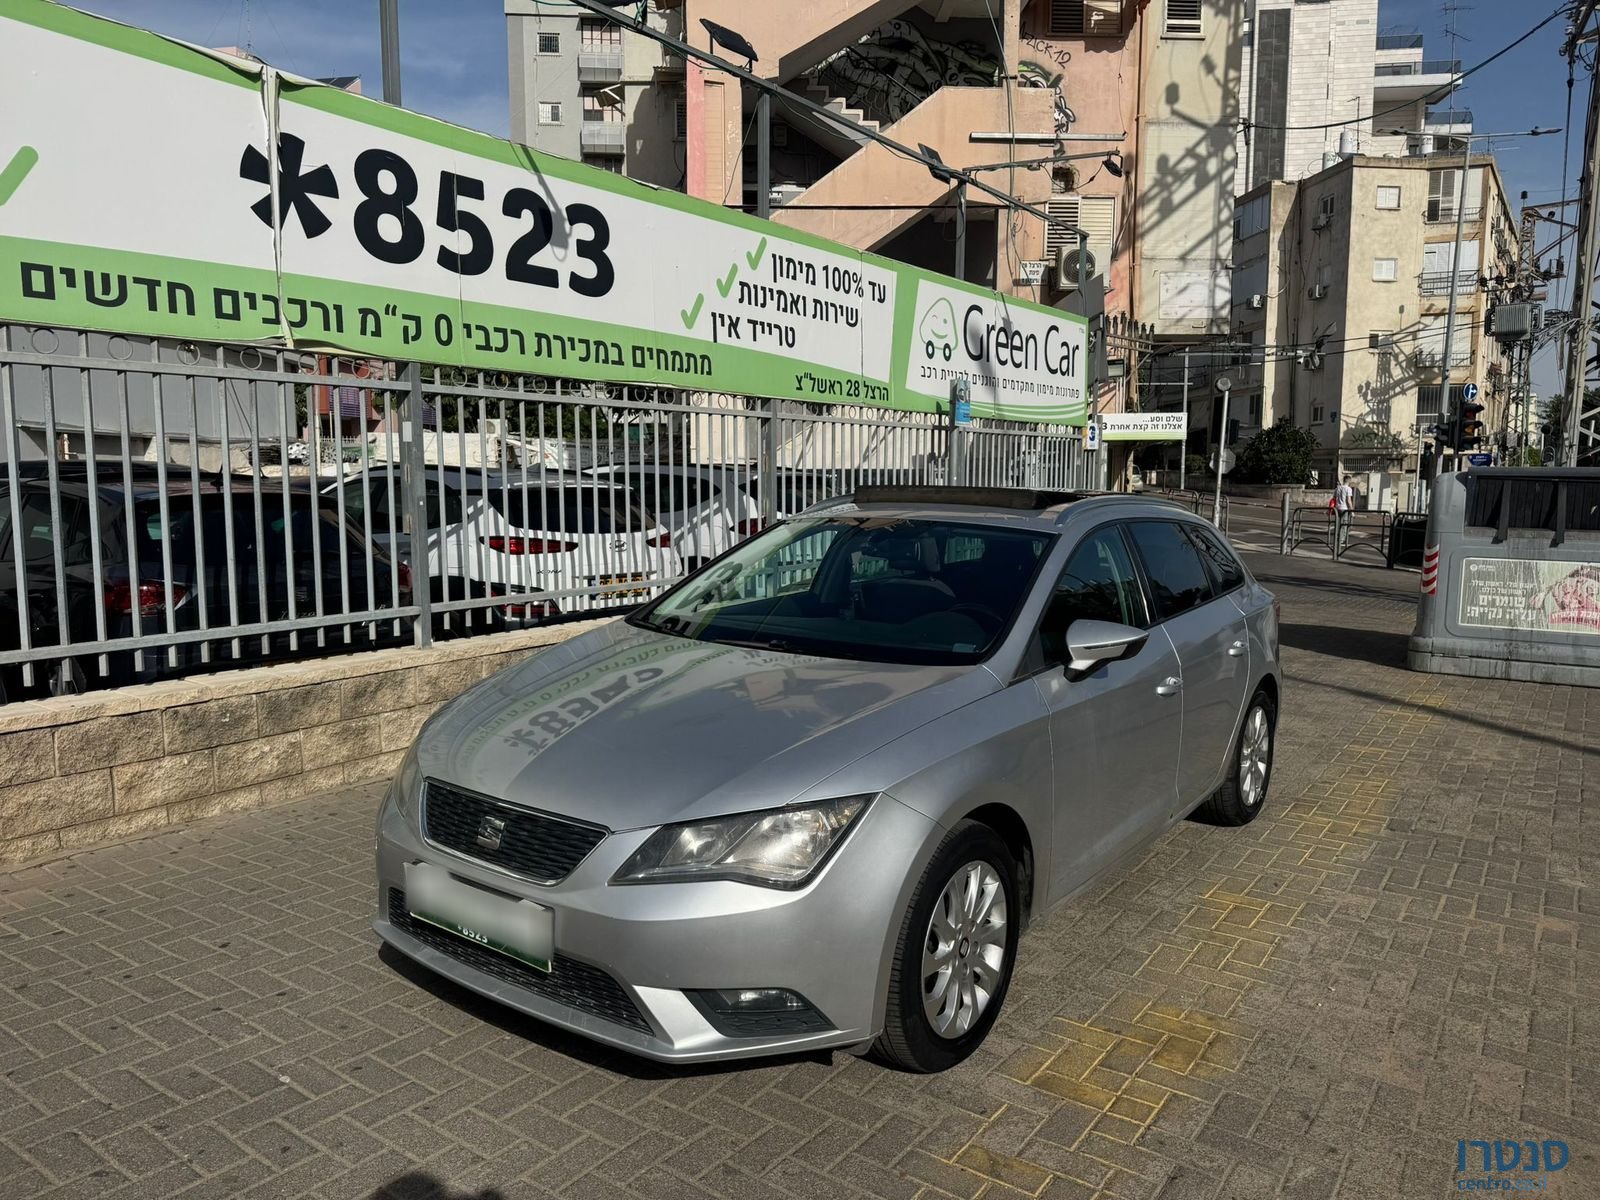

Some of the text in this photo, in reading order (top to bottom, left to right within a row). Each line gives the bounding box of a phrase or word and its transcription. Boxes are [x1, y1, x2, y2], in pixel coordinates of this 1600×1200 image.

[20, 261, 196, 316] חדשים
[771, 253, 887, 304] עד 100% מימון
[213, 287, 345, 334] ורכבים
[738, 281, 859, 328] שירות ואמינות
[434, 313, 453, 347] 0
[462, 322, 526, 355] רכבי
[711, 312, 796, 348] טרייד אין
[963, 304, 1080, 378] Green Car
[534, 331, 625, 366] במכירת
[631, 344, 713, 376] מתמחים
[795, 372, 889, 401] הרצל 28 ראשל"צ
[921, 365, 938, 379] רכב
[972, 373, 1000, 388] והוגנים
[1002, 378, 1035, 393] מתקדמים
[1036, 383, 1054, 397] מימון
[1056, 386, 1080, 399] פתרונות
[1132, 423, 1149, 431] קצת
[1161, 422, 1183, 430] אצלנו
[1165, 415, 1183, 423] שלם
